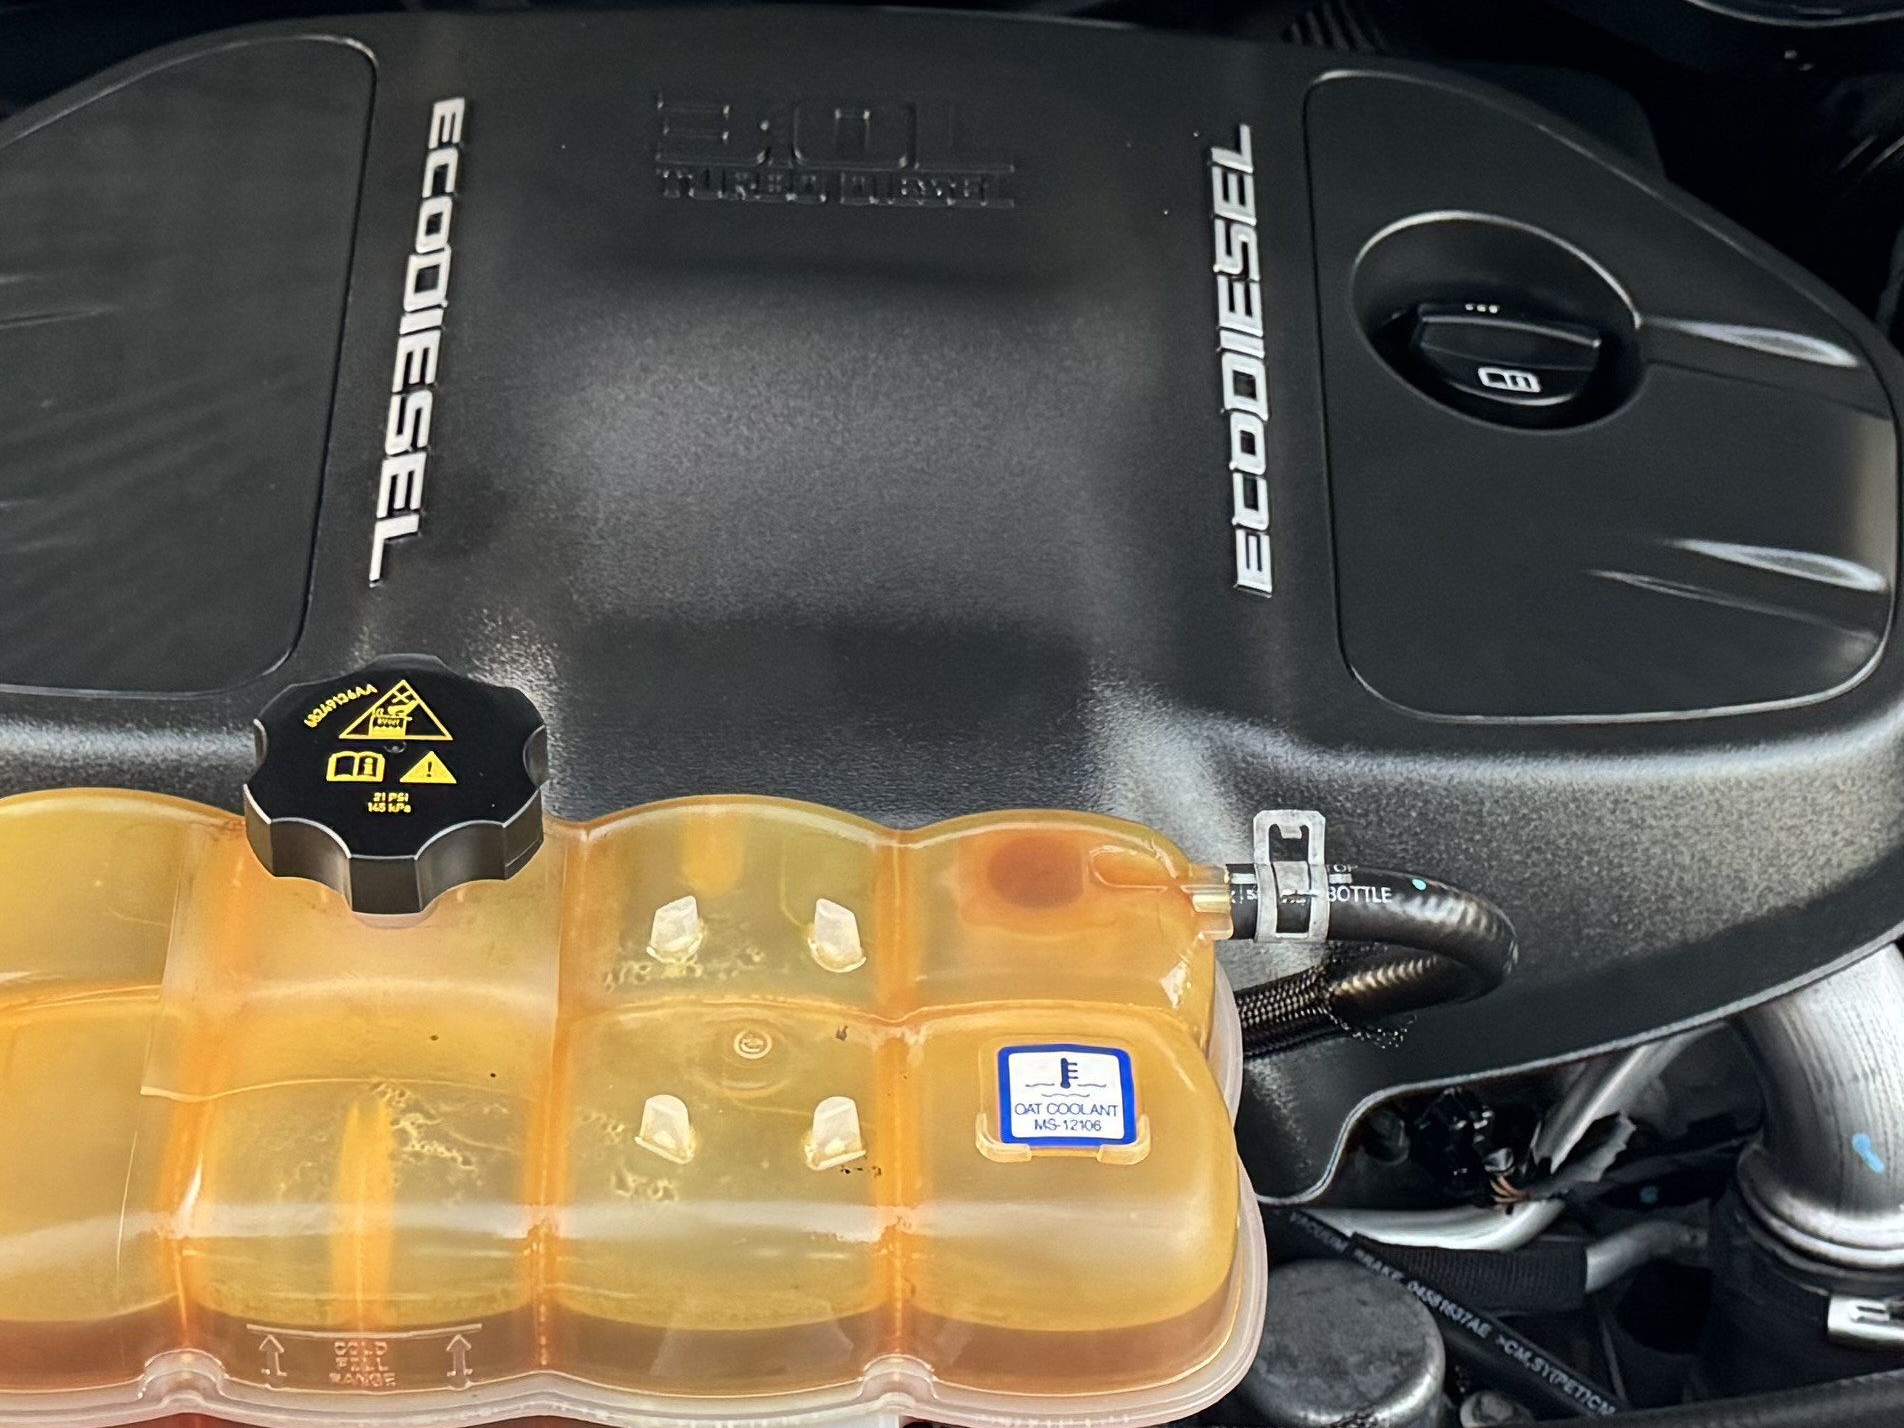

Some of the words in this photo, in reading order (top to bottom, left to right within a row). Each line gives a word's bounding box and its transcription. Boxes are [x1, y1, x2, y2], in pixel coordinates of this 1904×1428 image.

[369, 96, 466, 588] ECODIESEL
[1210, 124, 1273, 598] ECODIESEL
[388, 792, 409, 802] PSI
[1014, 1102, 1042, 1116] OAT
[1046, 1102, 1119, 1117] COOLANT
[1034, 1119, 1102, 1132] MS-12106
